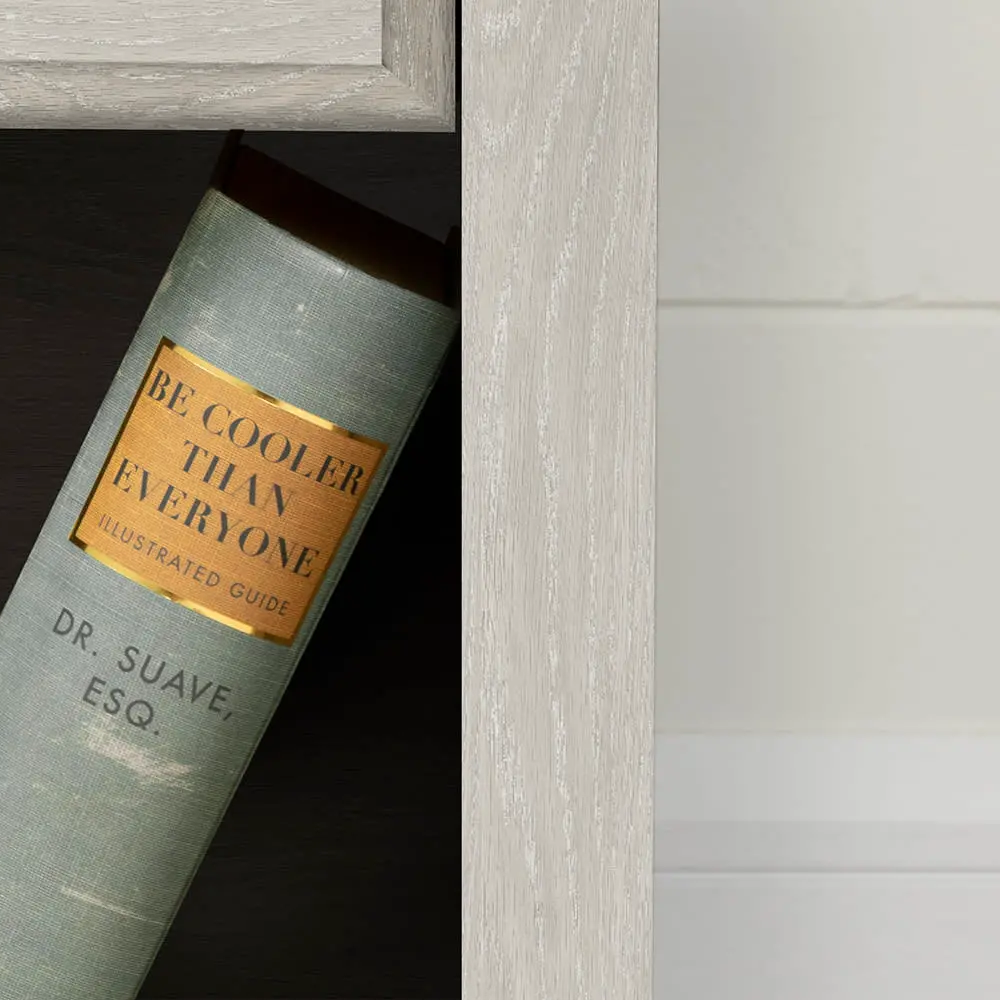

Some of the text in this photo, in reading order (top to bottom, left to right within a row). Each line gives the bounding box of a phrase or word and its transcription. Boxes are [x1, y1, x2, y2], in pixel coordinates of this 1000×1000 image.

[147, 368, 366, 497] BE COOLER
[183, 438, 295, 518] THAN
[98, 513, 292, 618] ILLUSTRATED GUIDE
[112, 457, 321, 579] EVERYONE
[51, 606, 235, 722] DR. SUAVE,
[82, 676, 161, 737] ESQ.
